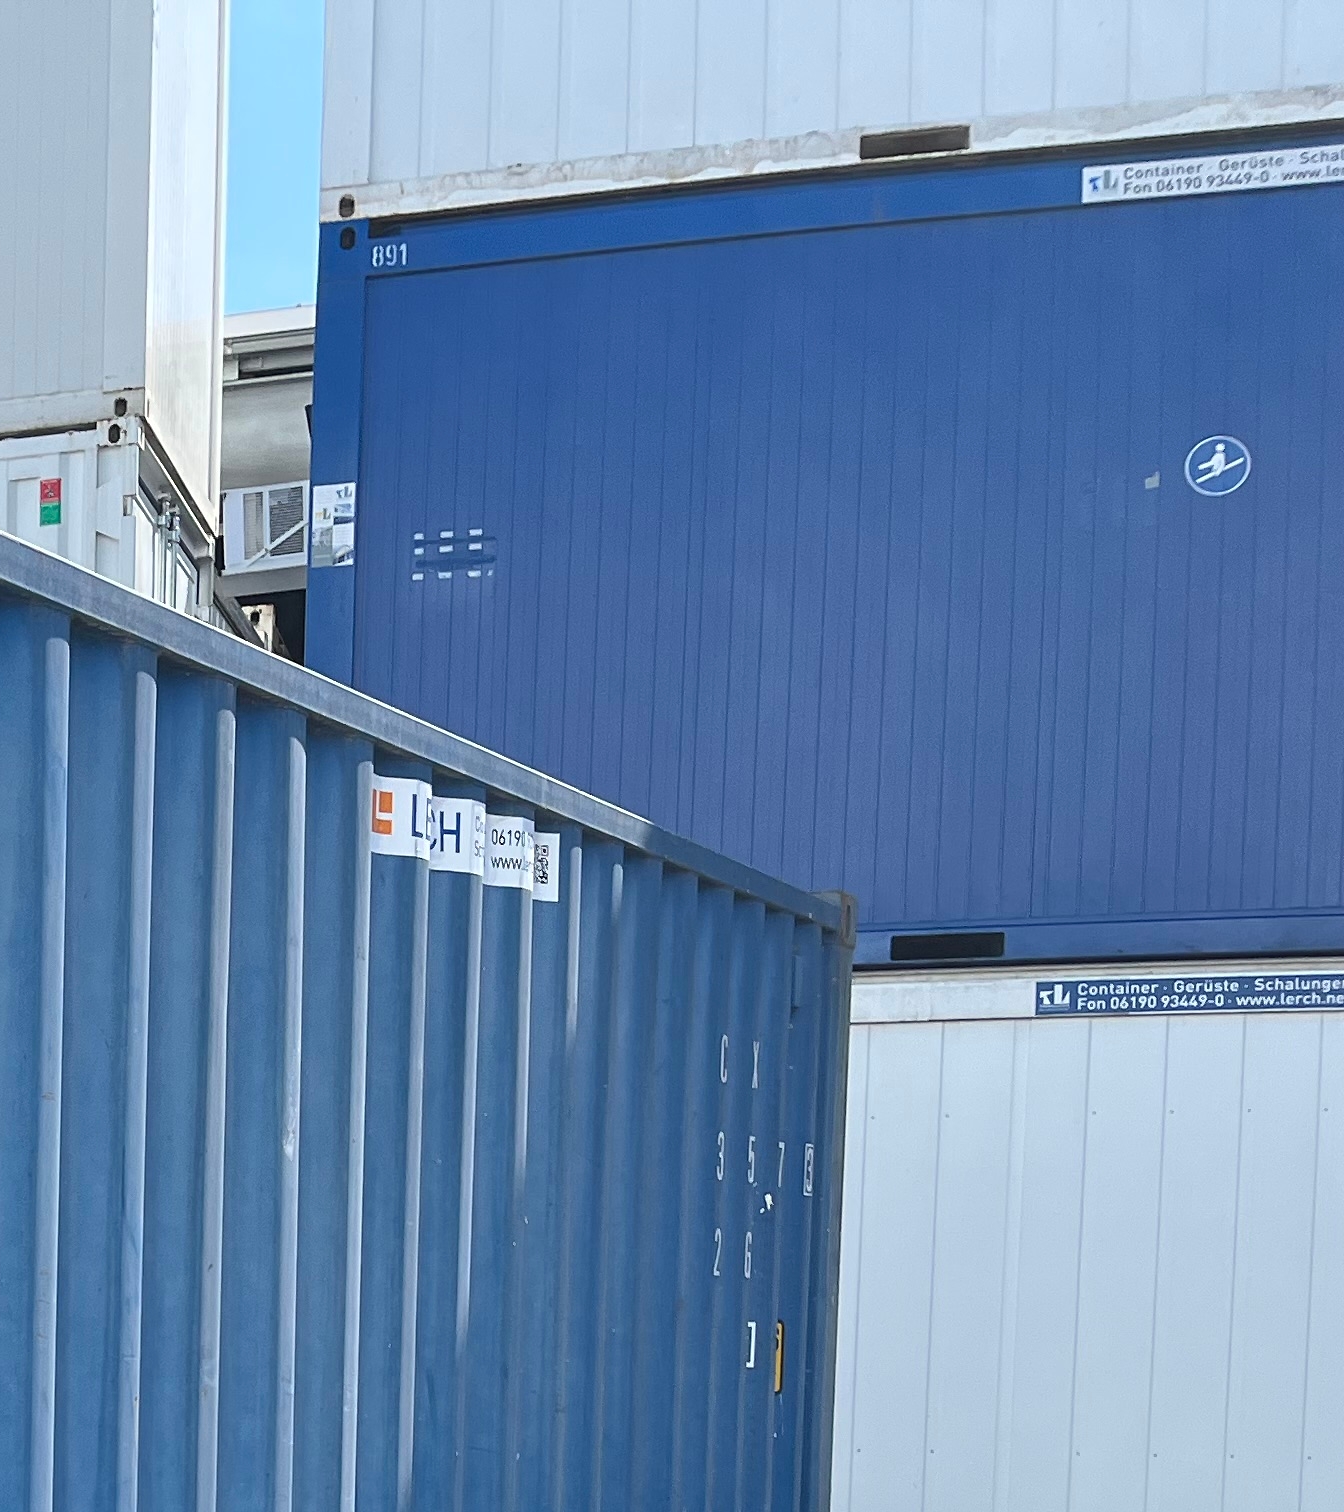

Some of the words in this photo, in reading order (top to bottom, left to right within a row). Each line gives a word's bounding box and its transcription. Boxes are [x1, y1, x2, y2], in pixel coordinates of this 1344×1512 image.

[1123, 162, 1204, 181] Container
[1123, 182, 1153, 195] Fon
[1156, 177, 1202, 194] 06190
[1206, 171, 1269, 188] 93449-0
[372, 243, 407, 267] 891
[1077, 982, 1159, 997] Container
[1174, 979, 1239, 994] Gerüste
[1254, 977, 1344, 994] Schalunge
[1077, 997, 1106, 1011] Fon
[1110, 995, 1158, 1010] 06190
[1162, 992, 1224, 1008] 93449-0
